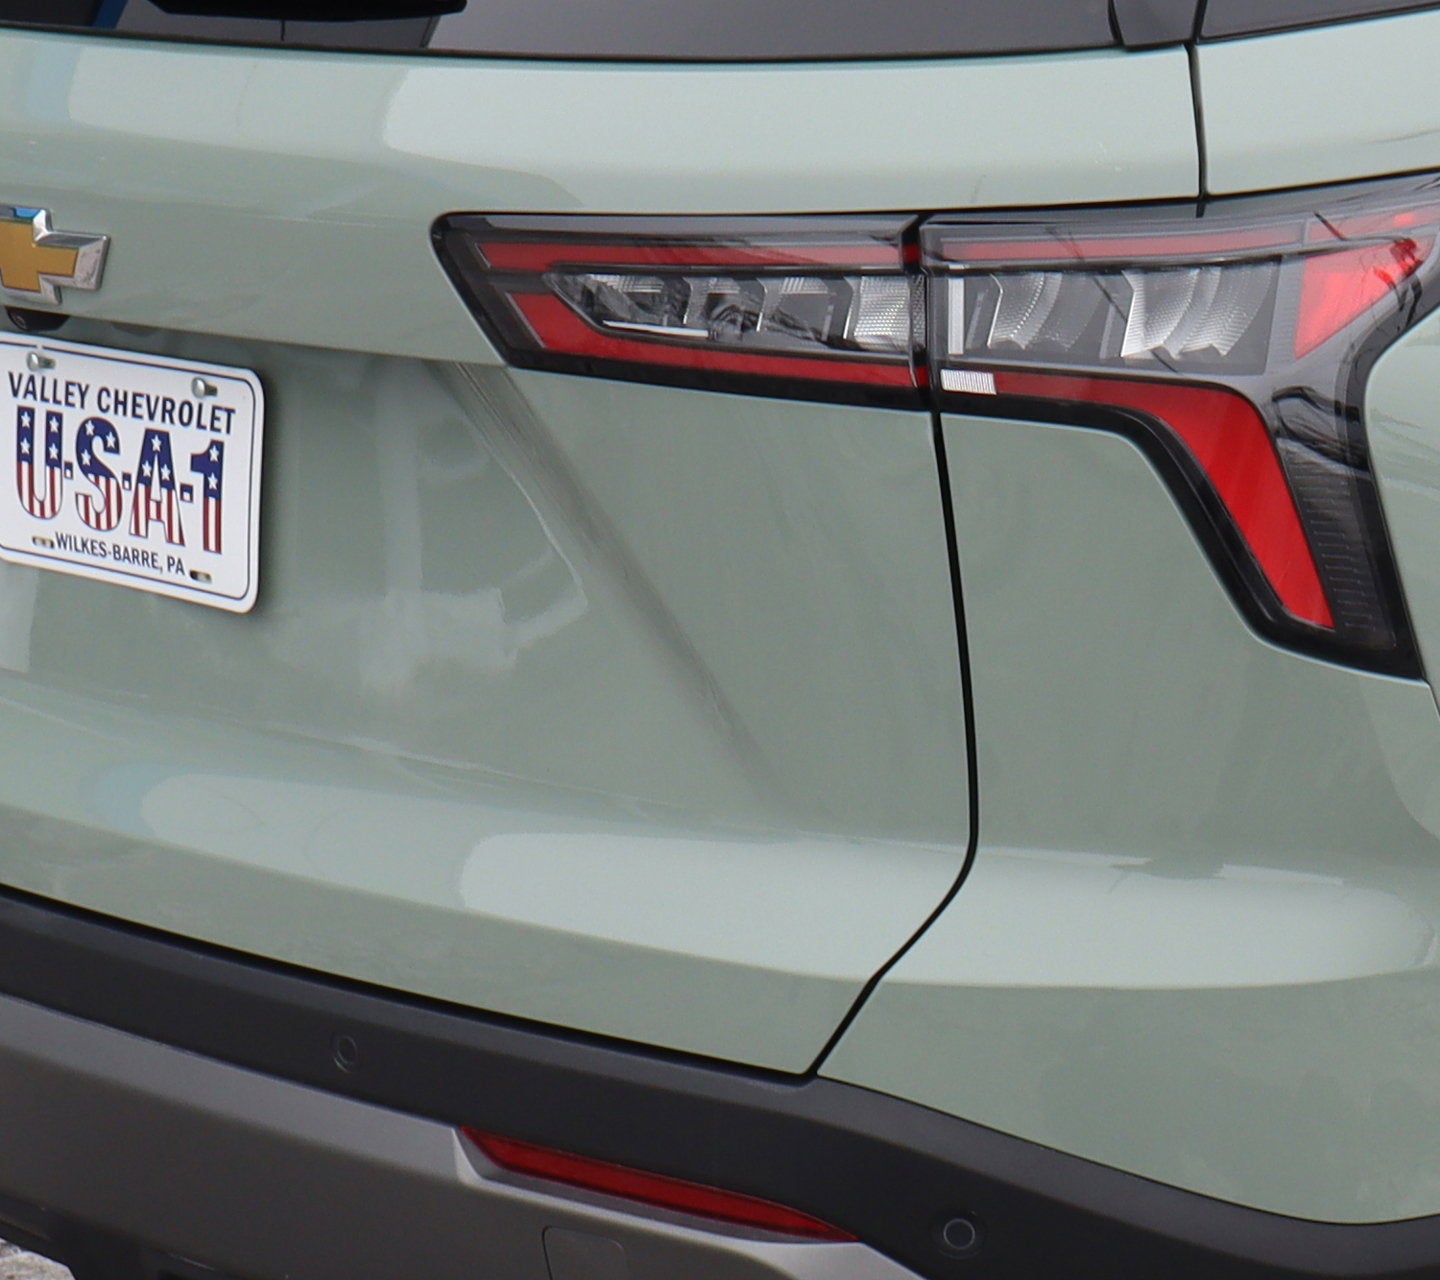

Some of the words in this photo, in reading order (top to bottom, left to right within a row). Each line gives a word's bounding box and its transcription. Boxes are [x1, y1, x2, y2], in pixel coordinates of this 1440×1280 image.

[8, 371, 90, 410] VALLEY
[96, 386, 237, 435] CHEVROLET
[55, 531, 163, 573] WILKES-BARRE,
[167, 555, 186, 576] PA
